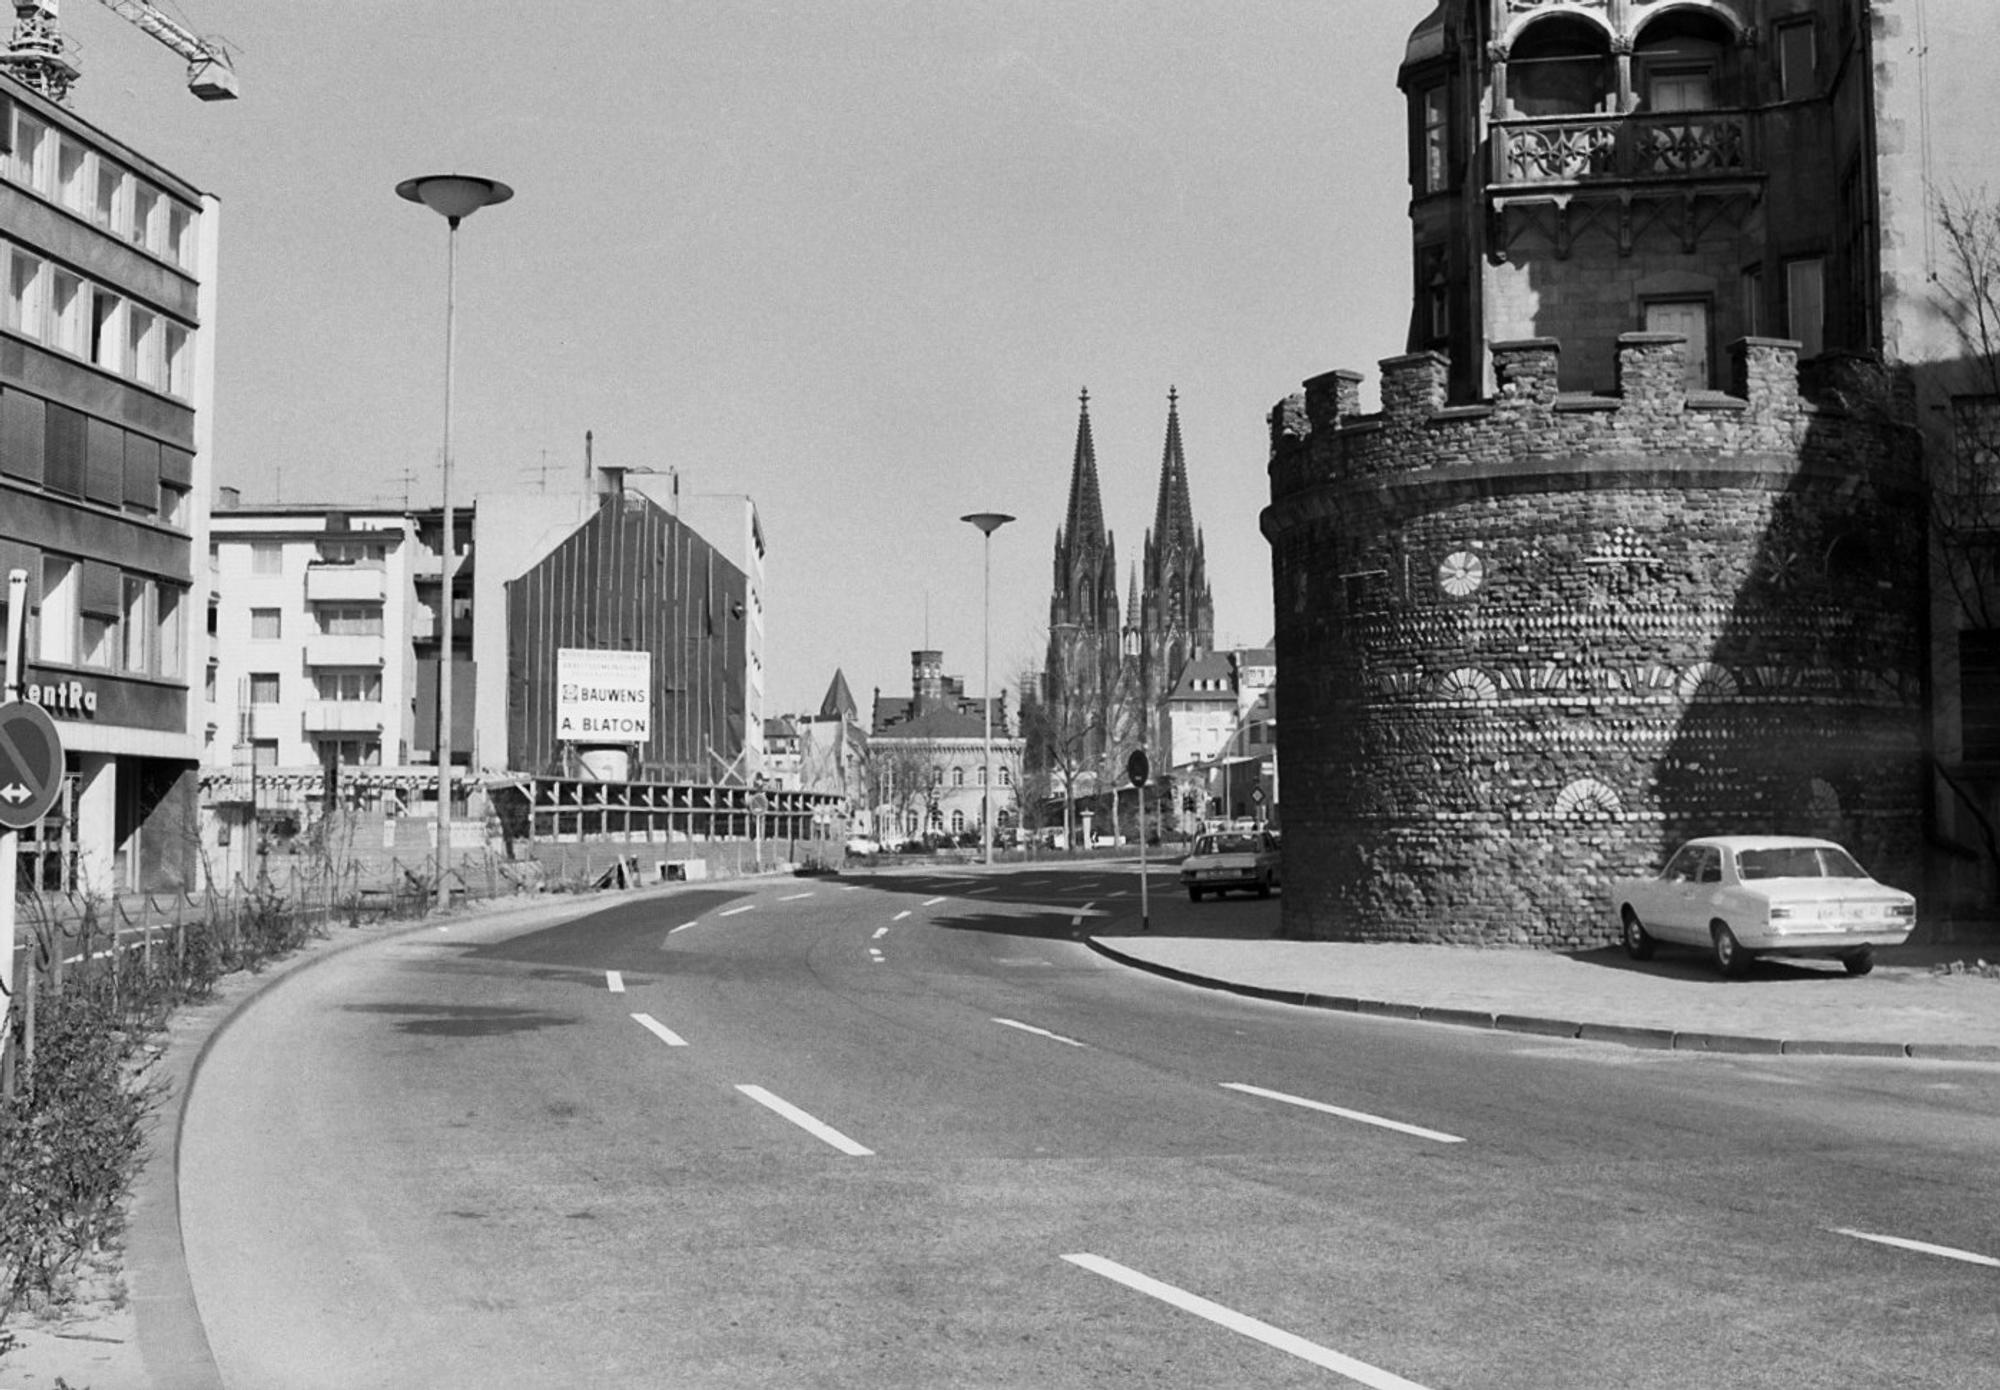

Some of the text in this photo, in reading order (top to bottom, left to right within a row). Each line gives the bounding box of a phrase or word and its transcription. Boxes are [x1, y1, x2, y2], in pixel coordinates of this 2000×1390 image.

[23, 681, 97, 711] entRa
[581, 688, 645, 703] BAUWENS
[583, 718, 645, 732] BLATON
